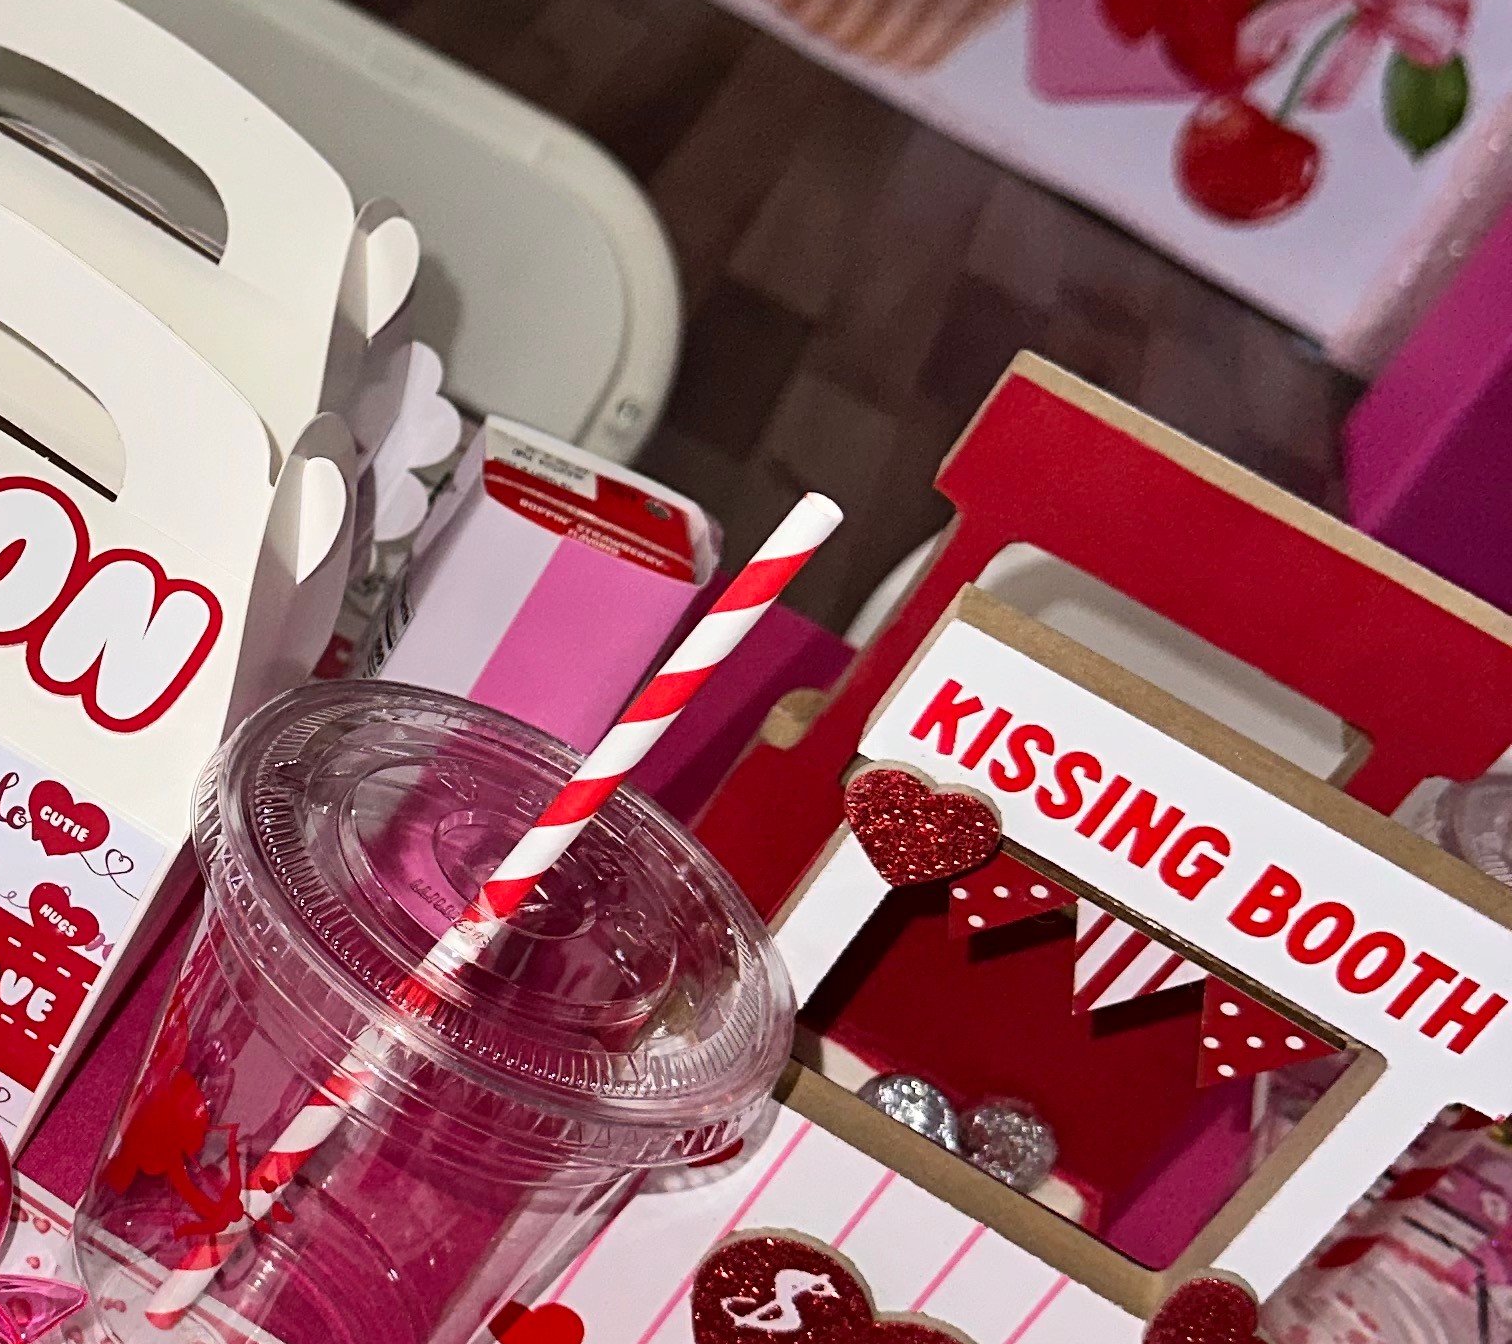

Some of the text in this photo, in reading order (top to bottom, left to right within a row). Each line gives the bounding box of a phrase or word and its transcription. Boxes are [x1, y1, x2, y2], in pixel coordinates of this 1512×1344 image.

[38, 805, 90, 843] CUTIE
[908, 678, 1510, 1055] KISSING BOOTH
[38, 903, 78, 939] HUGS
